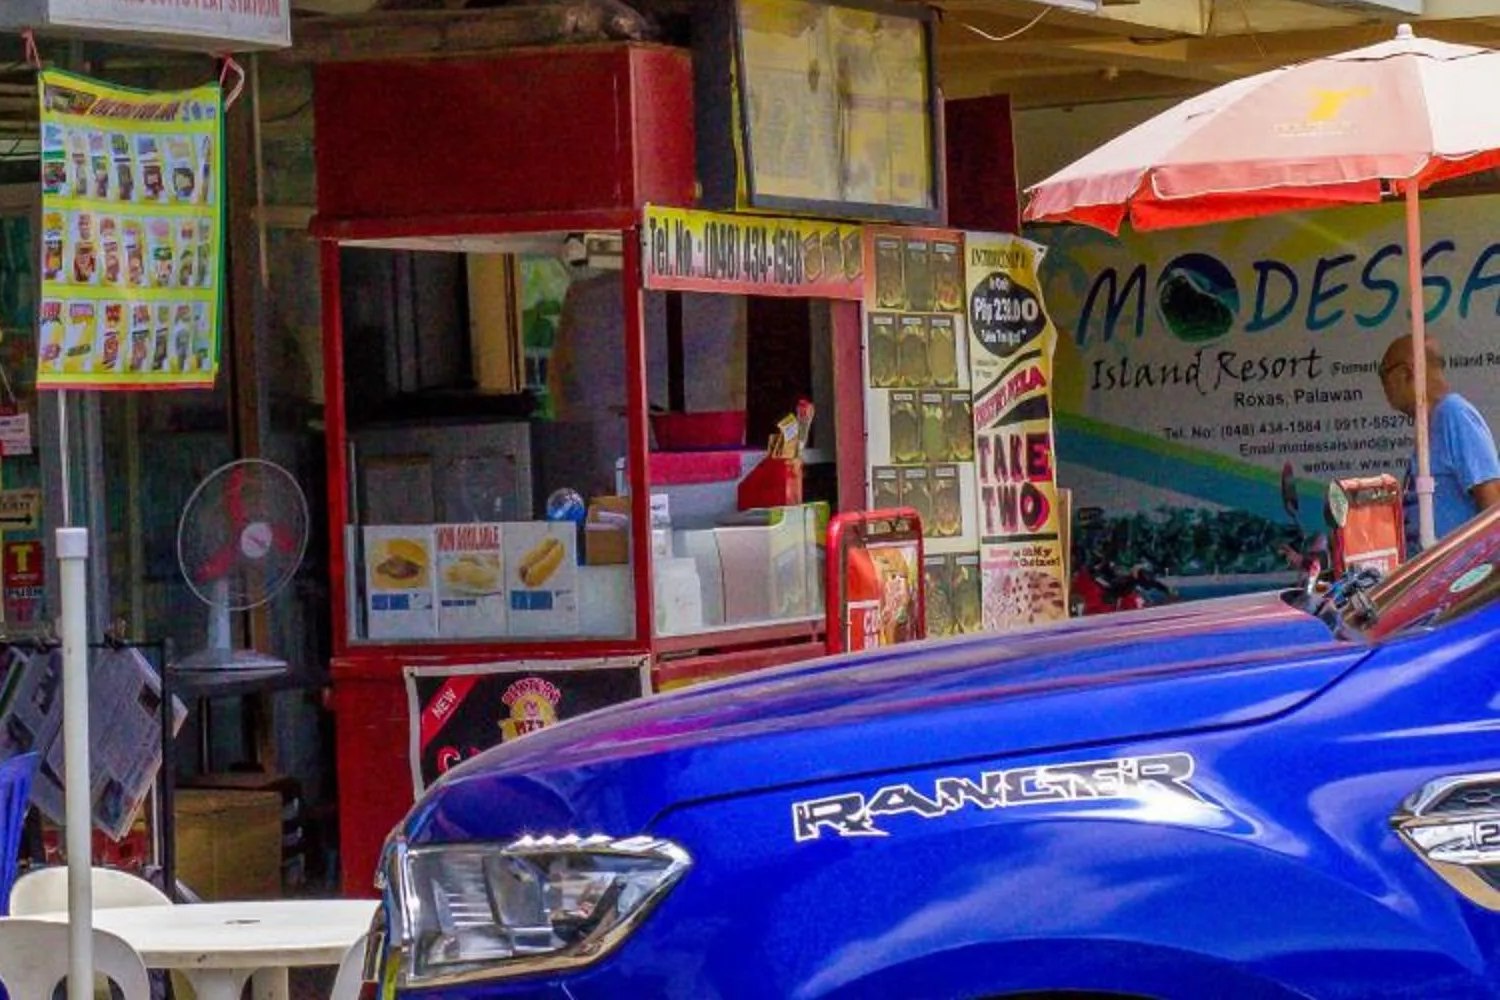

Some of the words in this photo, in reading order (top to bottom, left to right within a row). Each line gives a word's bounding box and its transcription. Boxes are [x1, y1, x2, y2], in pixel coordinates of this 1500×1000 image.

[649, 216, 673, 276] Tel.
[676, 218, 695, 277] No.
[1091, 349, 1207, 396] Island
[1214, 346, 1324, 391] Resort
[1450, 353, 1484, 369] Island
[1234, 391, 1289, 409] Roxas,
[1294, 387, 1364, 406] Palawan
[977, 431, 1052, 481] TAKE
[981, 481, 1051, 534] TWO
[432, 687, 457, 720] NEW
[792, 752, 1225, 842] RANGER
